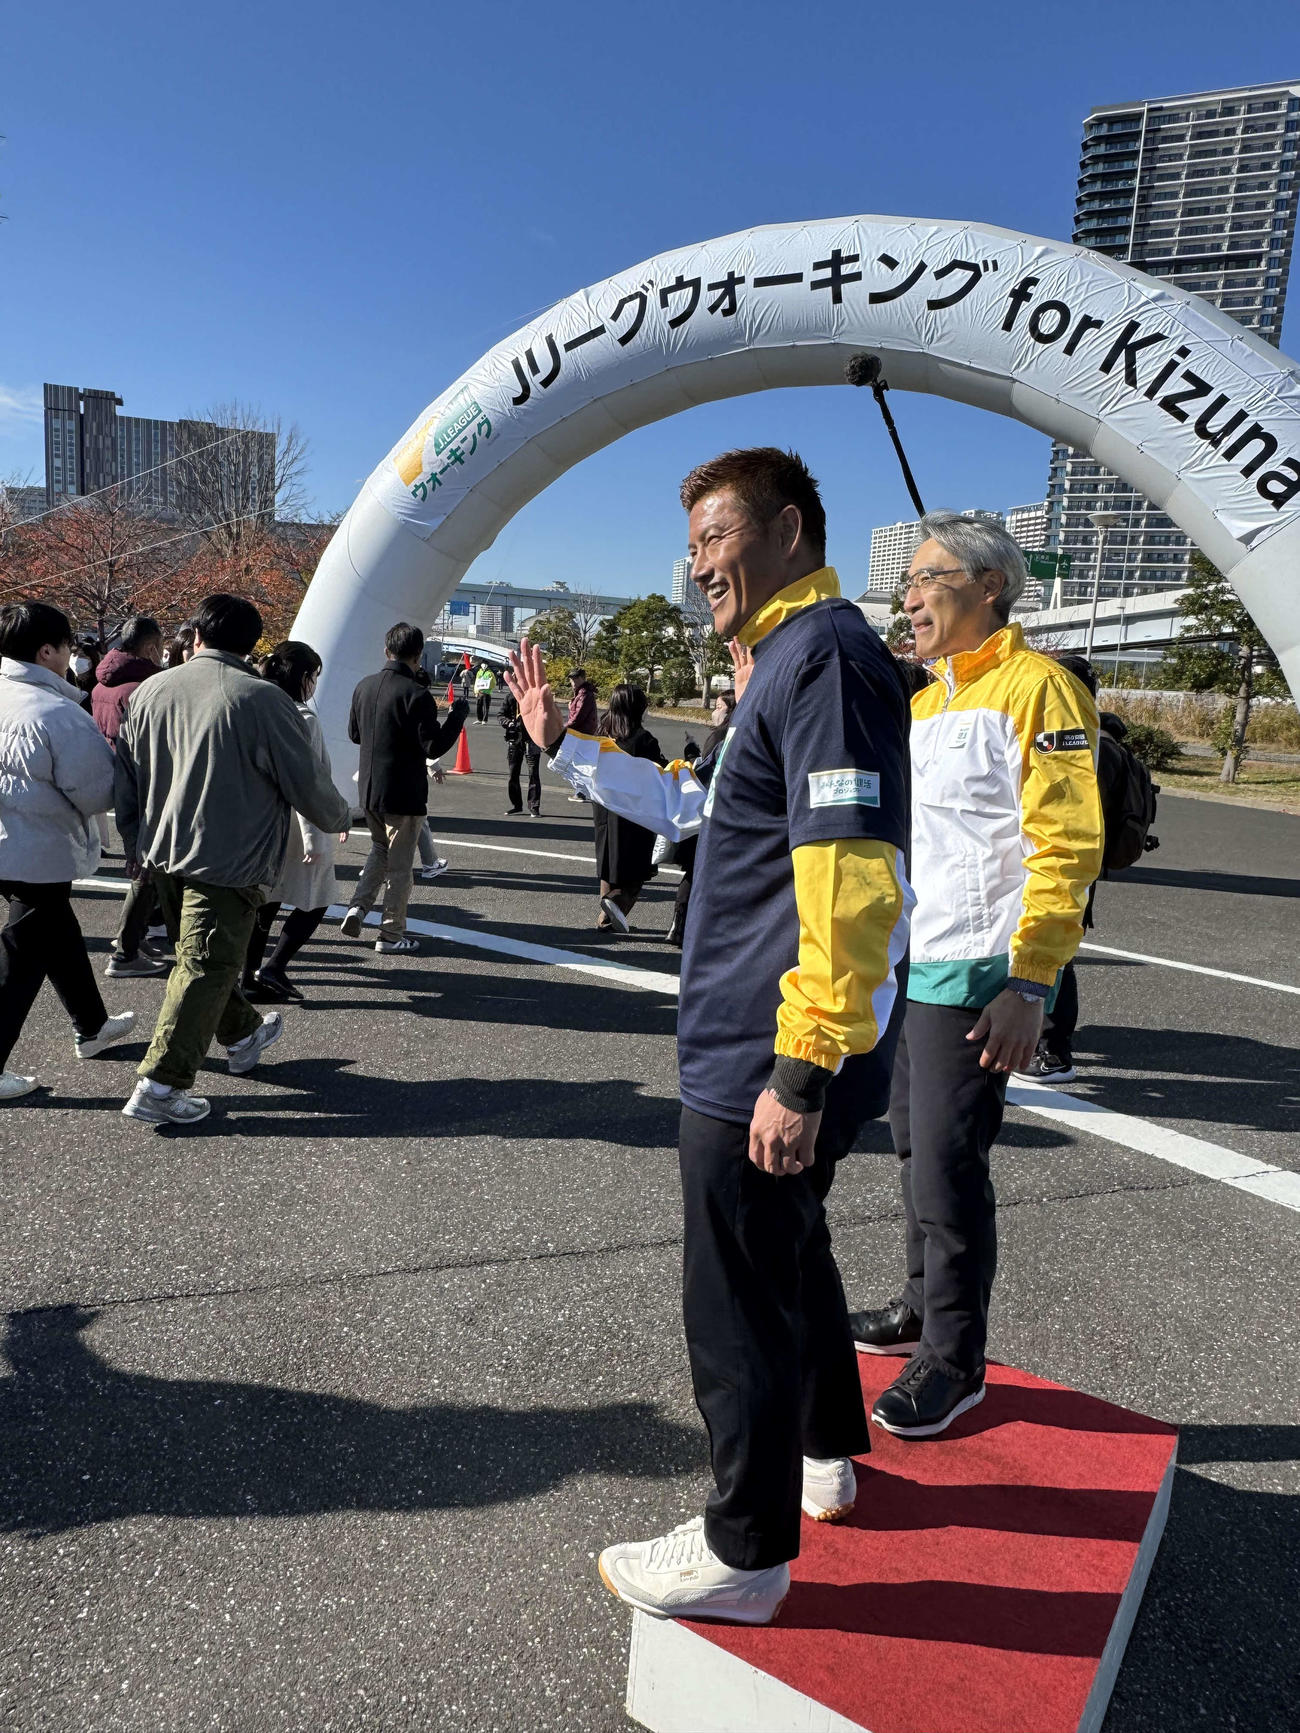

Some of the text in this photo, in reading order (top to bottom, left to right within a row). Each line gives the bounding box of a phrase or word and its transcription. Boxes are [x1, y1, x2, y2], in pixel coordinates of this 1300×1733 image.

[438, 404, 480, 449] J.LEAGUE
[512, 249, 1300, 512] Jリーグウォーキング for Kizuna
